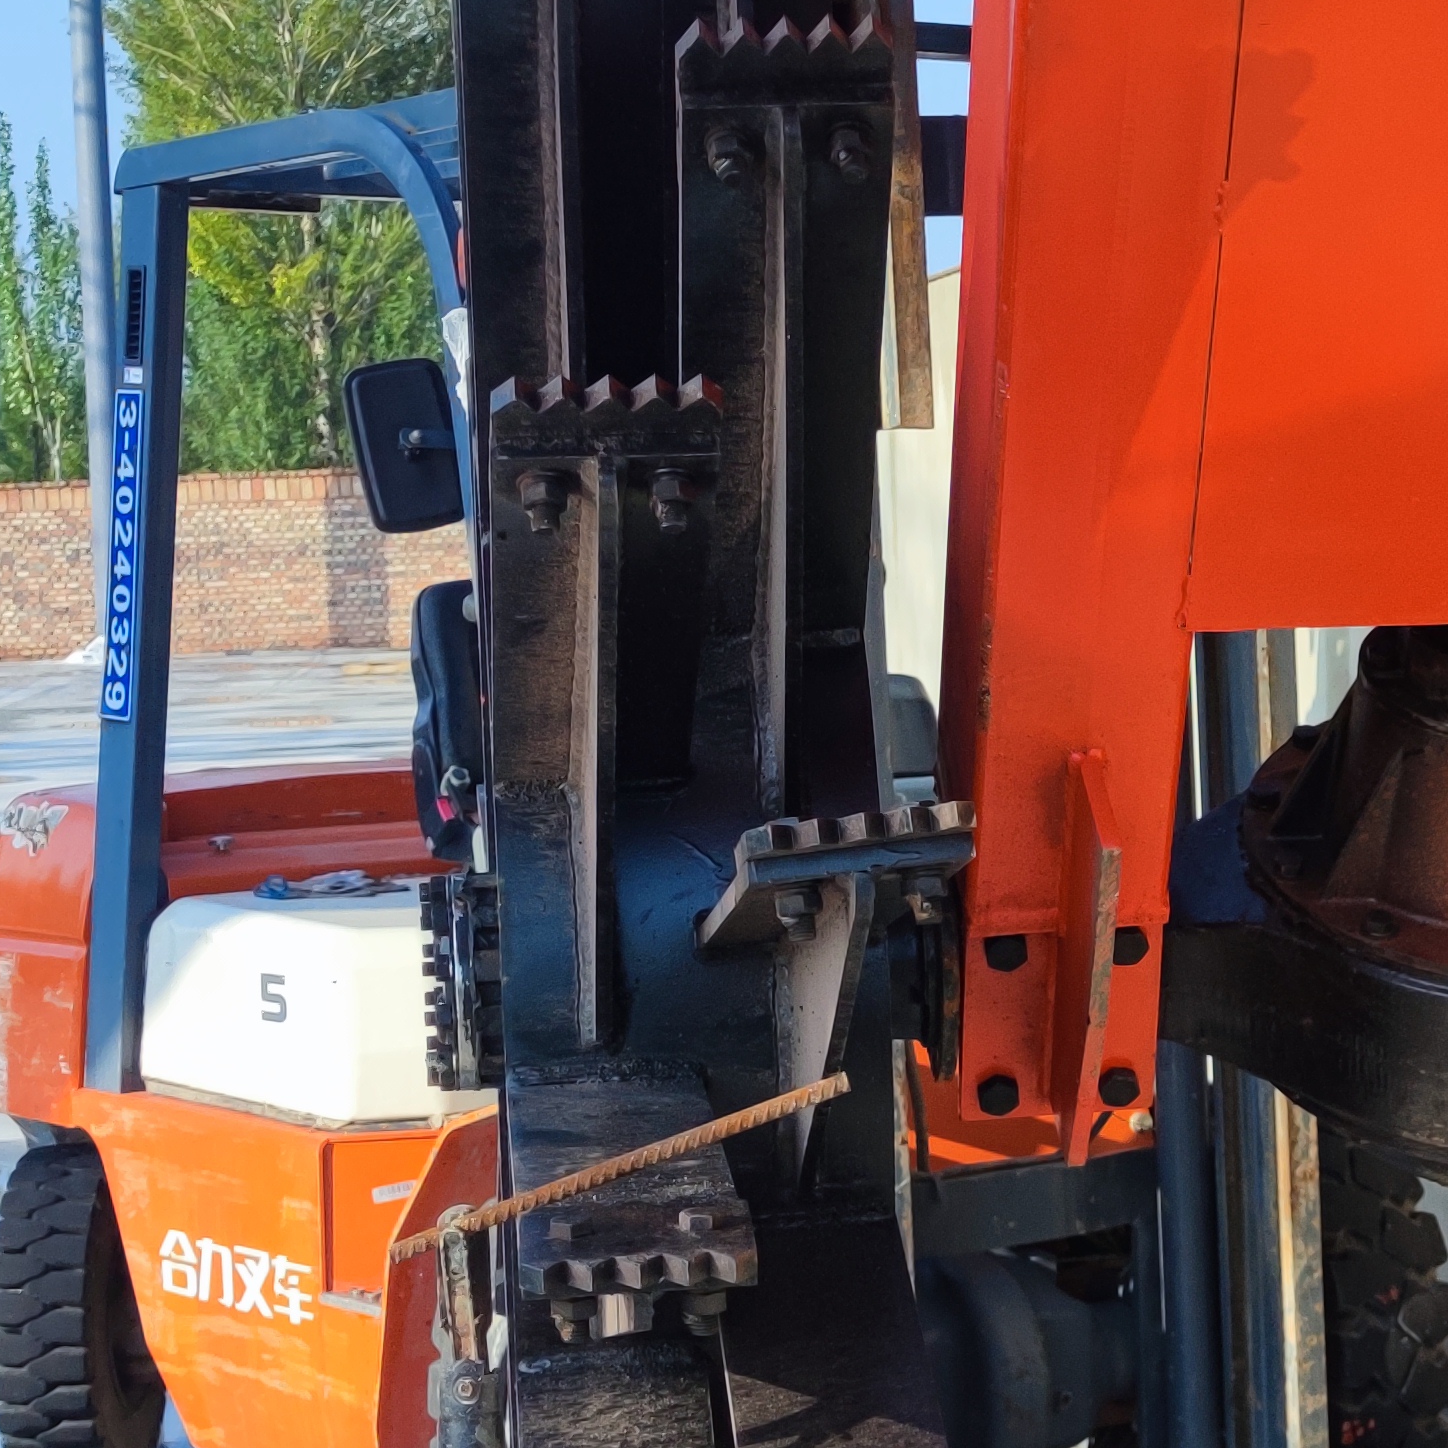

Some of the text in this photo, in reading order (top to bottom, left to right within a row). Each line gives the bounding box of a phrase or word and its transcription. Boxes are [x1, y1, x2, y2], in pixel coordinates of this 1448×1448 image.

[103, 399, 138, 712] 3-40240329
[260, 973, 287, 1023] 5
[158, 1229, 315, 1325] 合力叉车
